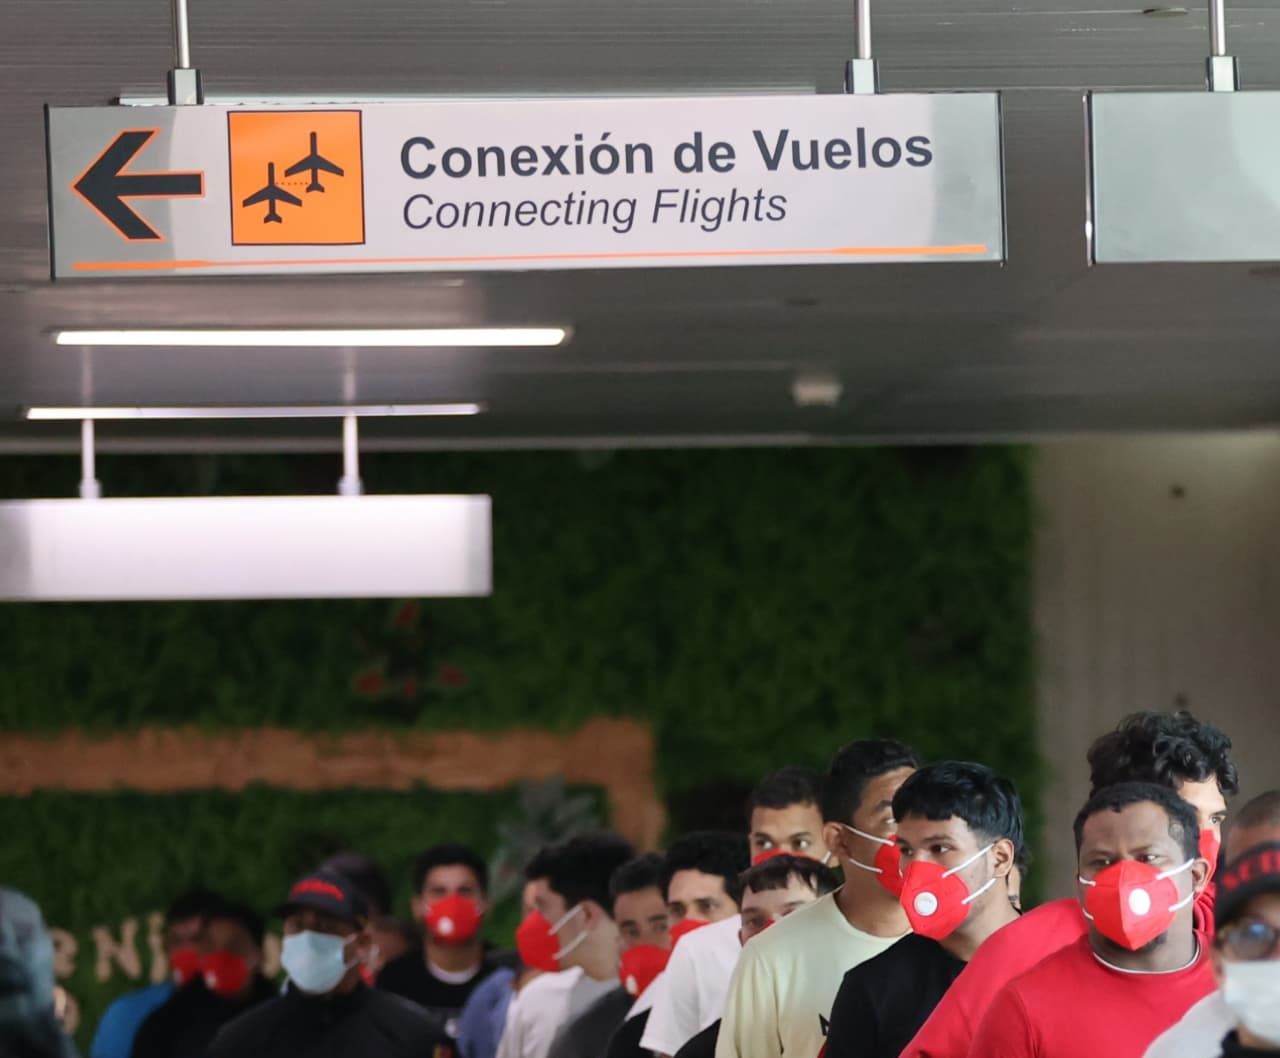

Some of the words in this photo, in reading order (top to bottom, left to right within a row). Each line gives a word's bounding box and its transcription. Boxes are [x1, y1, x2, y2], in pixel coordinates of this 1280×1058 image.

[400, 131, 654, 180] Conexión
[673, 131, 736, 174] de
[752, 127, 933, 172] Vuelos
[403, 191, 637, 234] Connecting
[652, 187, 787, 233] Flights
